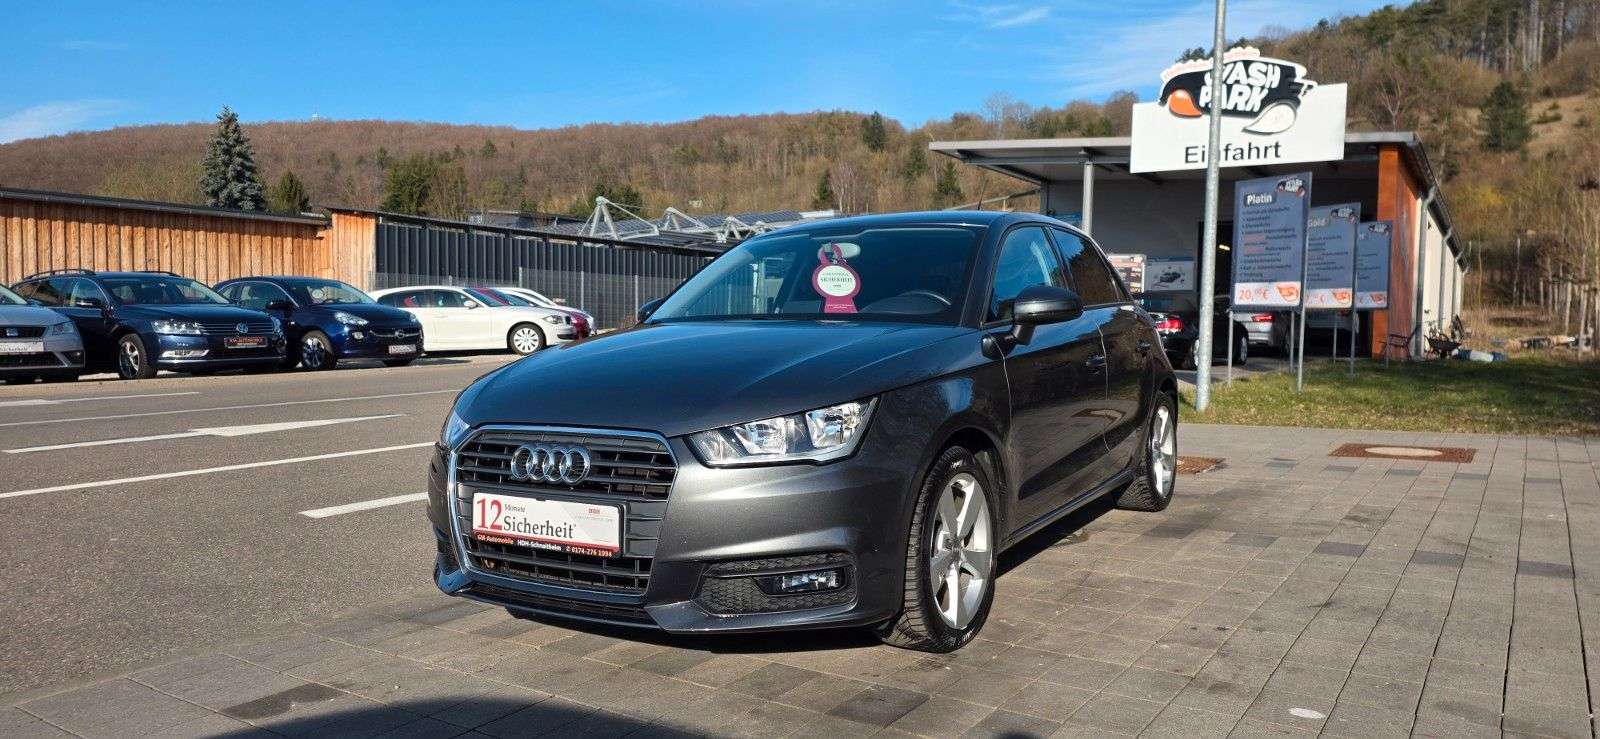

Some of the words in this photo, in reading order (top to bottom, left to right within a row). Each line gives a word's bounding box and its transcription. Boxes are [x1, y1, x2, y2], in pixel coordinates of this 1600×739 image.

[1184, 141, 1282, 164] Eifahrt
[1246, 194, 1273, 206] Platin
[476, 496, 501, 530] 12
[503, 515, 575, 539] Sicherheit
